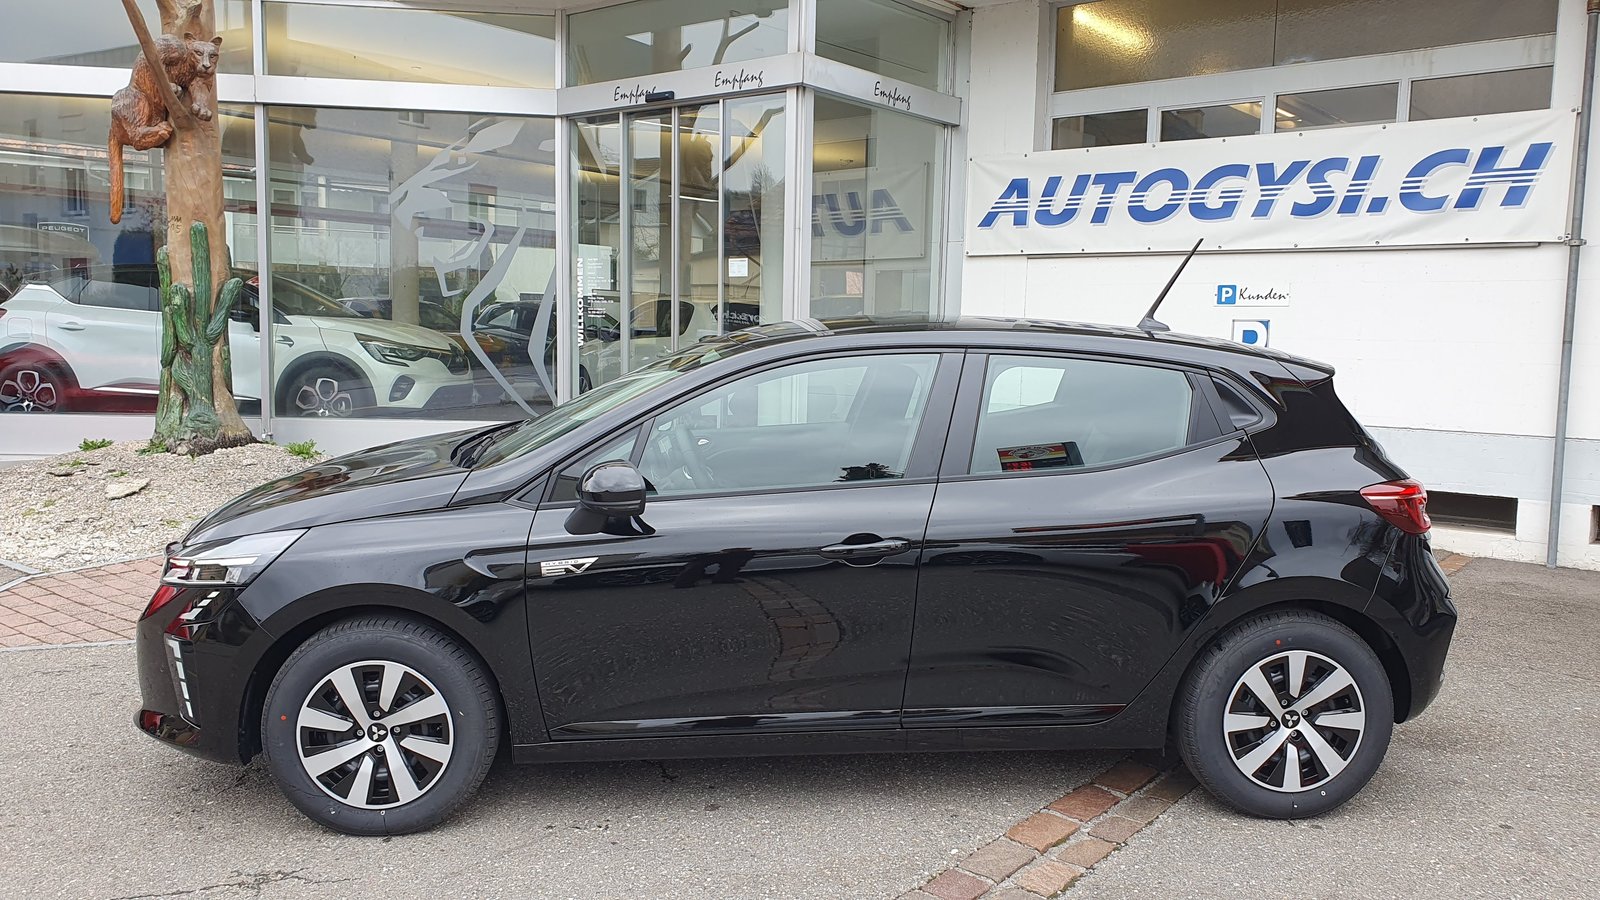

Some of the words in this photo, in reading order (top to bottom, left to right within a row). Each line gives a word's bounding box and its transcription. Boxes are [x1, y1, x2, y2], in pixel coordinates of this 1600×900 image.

[714, 68, 764, 90] Empfang
[873, 81, 912, 111] Empfang
[976, 141, 1556, 230] AUTOGYSI.CH
[41, 225, 86, 233] PEUGEOT
[1221, 287, 1233, 303] P
[1239, 287, 1286, 300] Kunden
